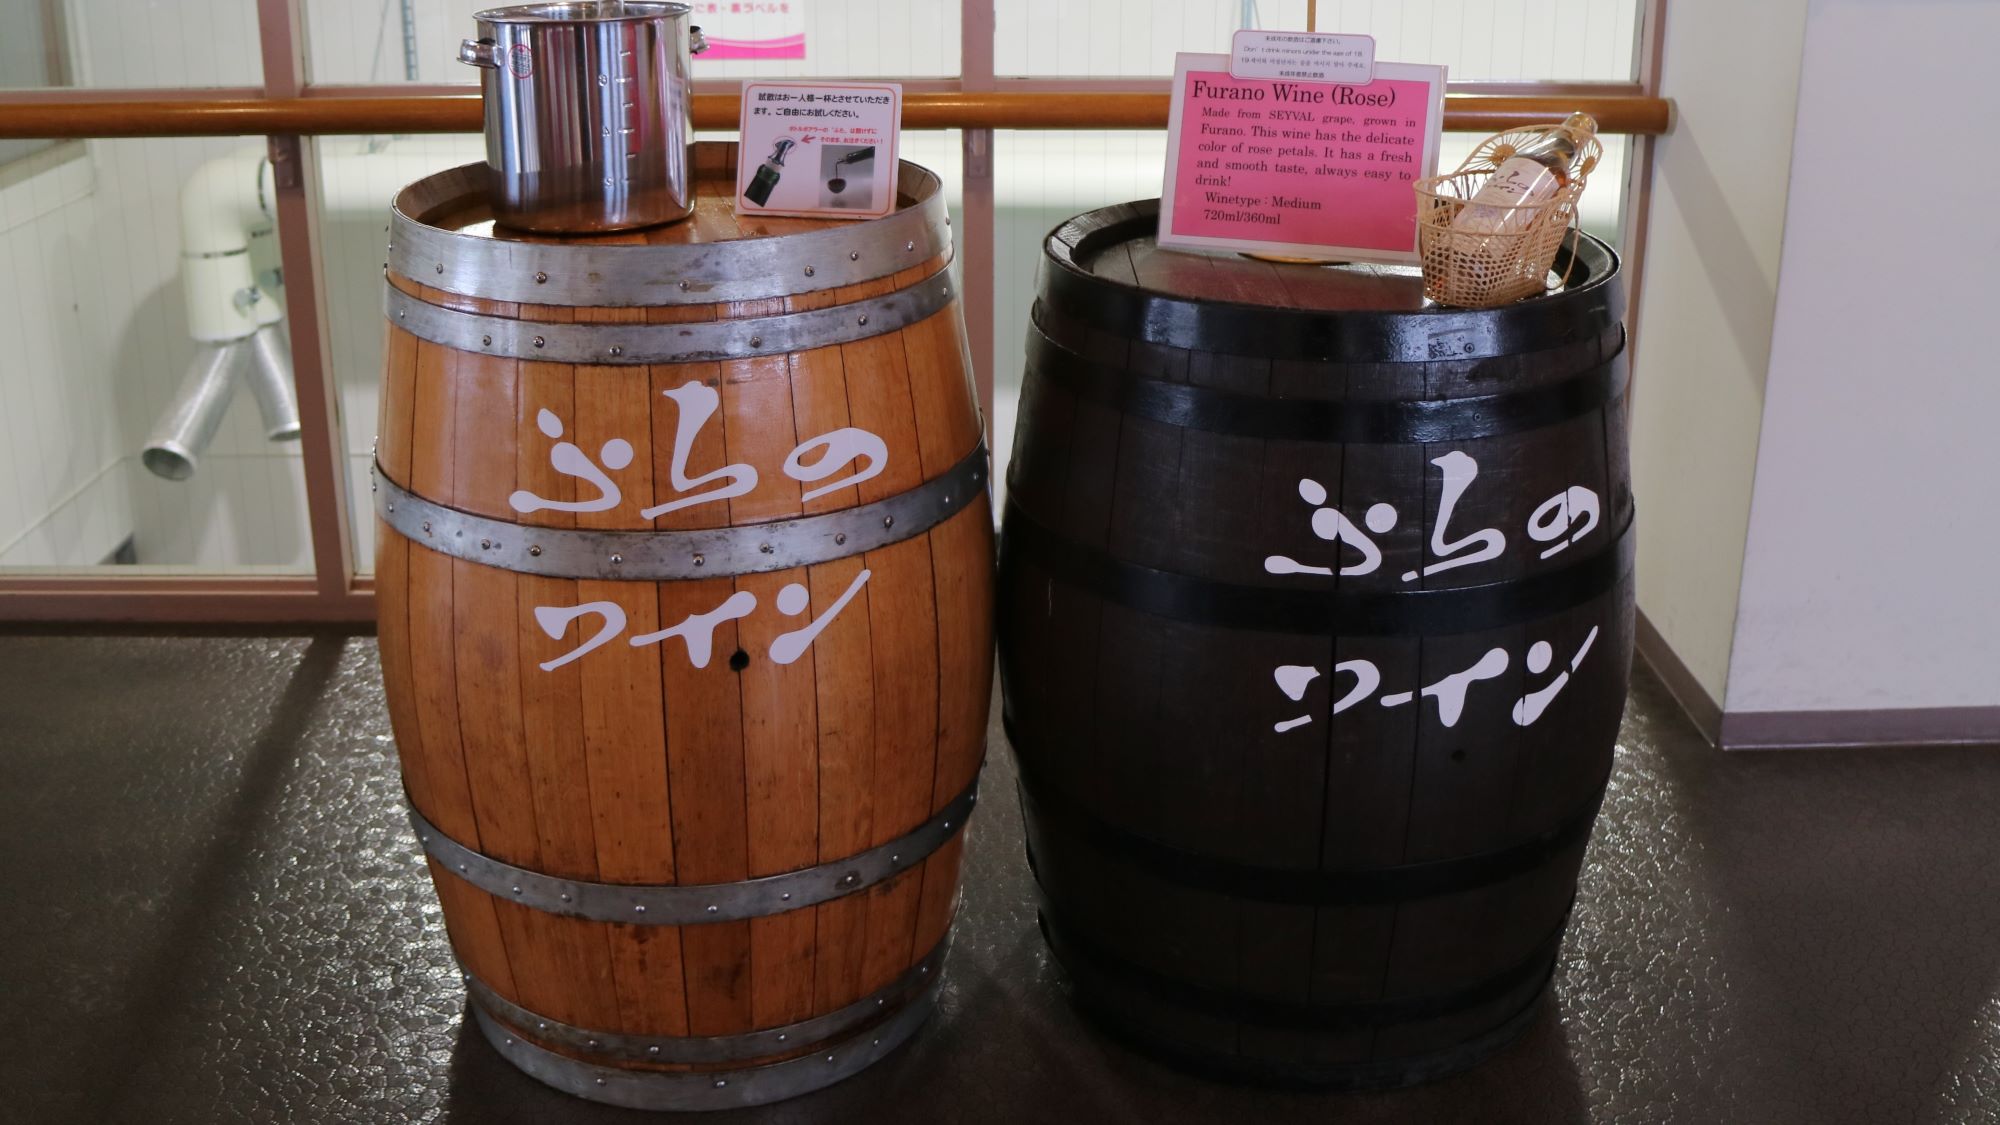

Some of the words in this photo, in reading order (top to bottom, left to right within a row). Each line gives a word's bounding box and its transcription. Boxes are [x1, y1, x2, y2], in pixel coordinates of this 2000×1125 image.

[758, 92, 890, 104] 試飲はお一人様一杯とさせていただき
[1191, 81, 1265, 101] Furano
[1272, 83, 1324, 104] Wine
[1331, 84, 1396, 108] (Rose)
[753, 107, 860, 118] ます。ご自由にお試しください。
[1202, 107, 1230, 117] Made
[1237, 109, 1261, 119] from
[1269, 110, 1315, 122] SEYVAL
[1322, 113, 1355, 125] grape,
[1364, 116, 1397, 127] grown
[1405, 116, 1416, 127] in
[1200, 124, 1246, 136] Furano.
[1251, 126, 1277, 138] This
[1282, 128, 1311, 139] wine
[1315, 129, 1337, 141] has
[1341, 131, 1361, 142] the
[1366, 132, 1414, 145] delicate
[1198, 142, 1226, 152] color
[1231, 143, 1243, 153] of
[1248, 145, 1272, 154] rose
[1278, 146, 1318, 159] petals.
[1324, 147, 1334, 158] It
[1341, 148, 1362, 160] has
[1367, 152, 1375, 161] a
[1380, 150, 1412, 163] fresh
[1196, 159, 1219, 169] and
[1225, 161, 1268, 172] smooth
[1275, 163, 1308, 175] taste,
[1315, 165, 1357, 178] always
[1364, 169, 1392, 181] easy
[1399, 168, 1412, 180] to
[1195, 176, 1231, 187] drink!
[1205, 191, 1261, 207] Winetype
[1272, 194, 1322, 210] Medium
[1204, 209, 1281, 225] 720ml/360ml
[508, 380, 888, 520] ふらの
[1264, 450, 1600, 582] ふらの
[534, 569, 871, 672] ワイン
[1274, 625, 1599, 733] ワイン
